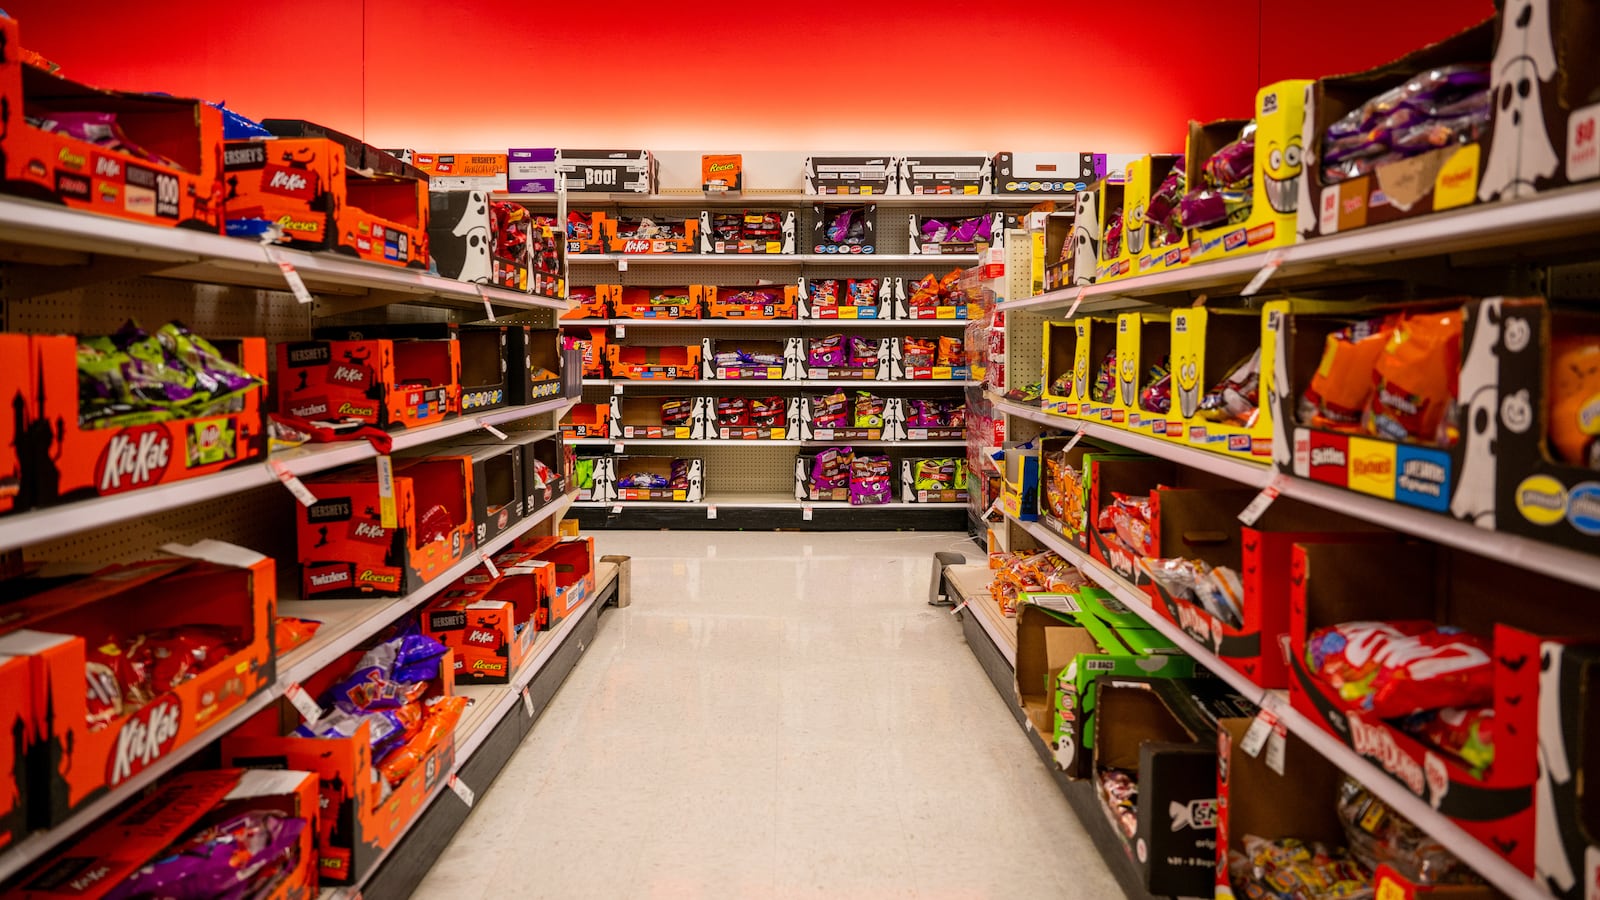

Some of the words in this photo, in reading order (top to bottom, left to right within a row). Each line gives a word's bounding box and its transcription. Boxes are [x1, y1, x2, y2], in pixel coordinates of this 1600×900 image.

[585, 167, 617, 185] BOO!
[101, 430, 170, 491] KitKat
[111, 701, 179, 786] KitKat
